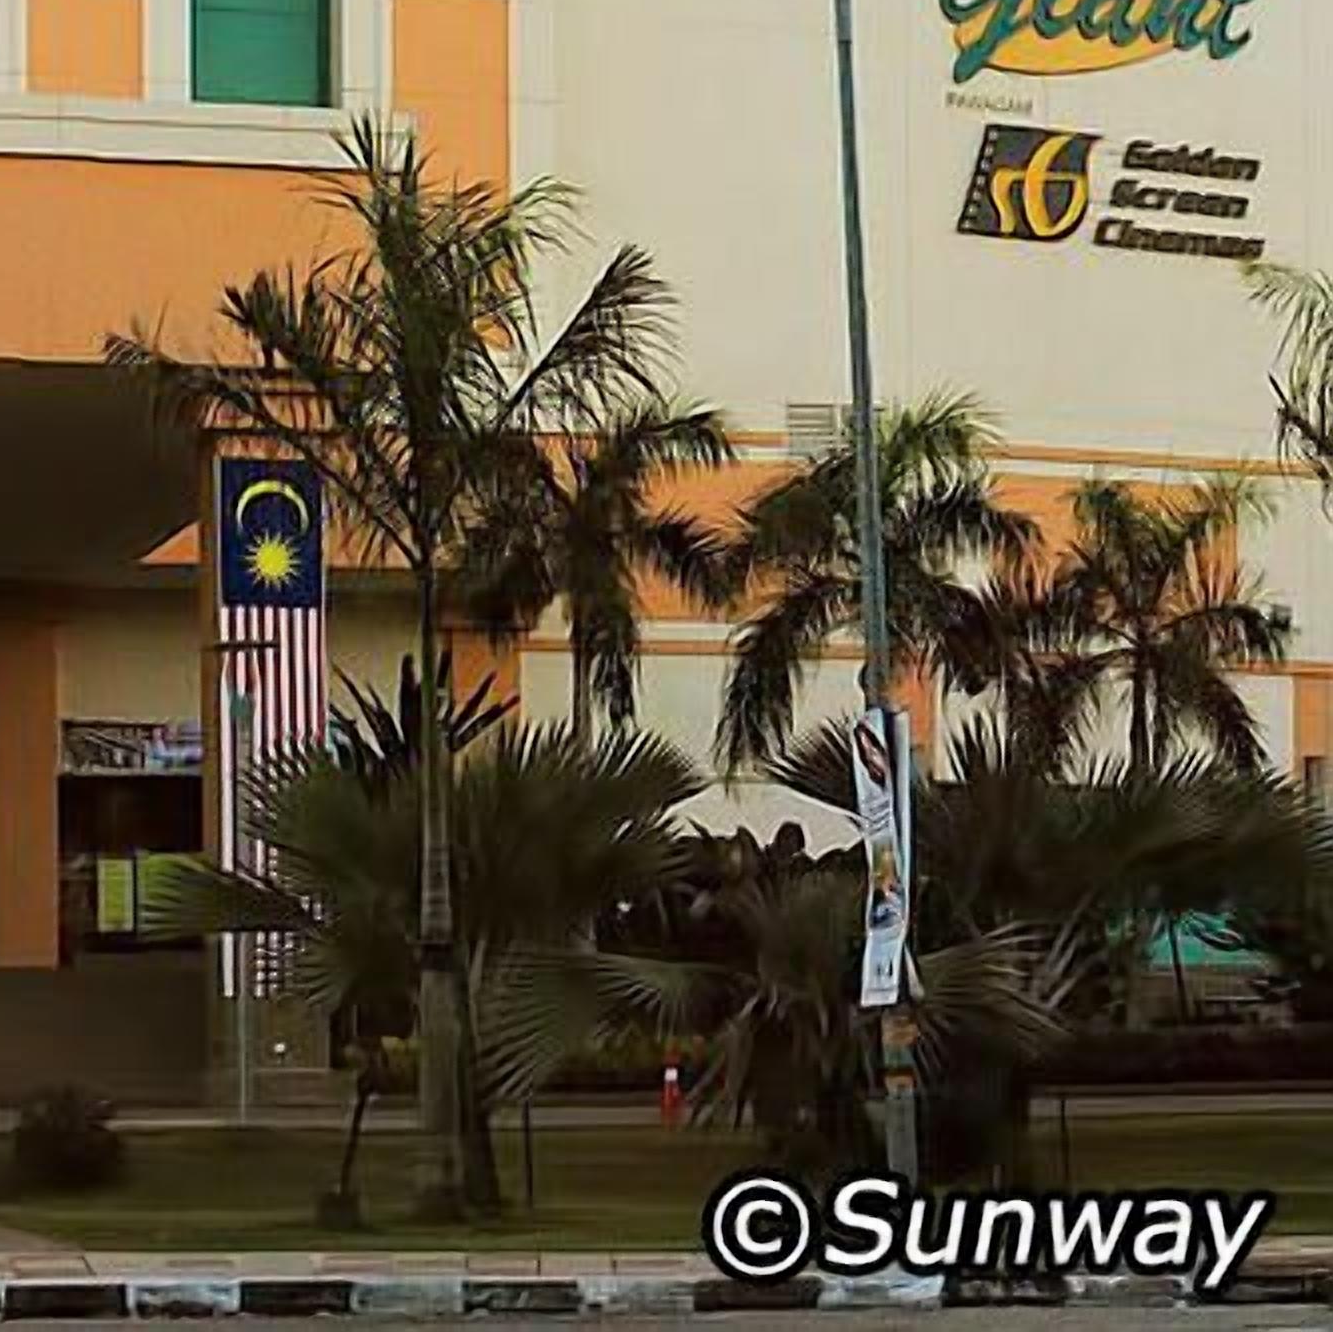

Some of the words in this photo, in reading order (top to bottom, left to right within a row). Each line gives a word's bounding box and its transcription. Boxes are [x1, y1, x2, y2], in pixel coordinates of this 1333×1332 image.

[1122, 139, 1261, 181] Golden
[1109, 179, 1249, 219] Screen
[1093, 217, 1267, 260] Cinemas
